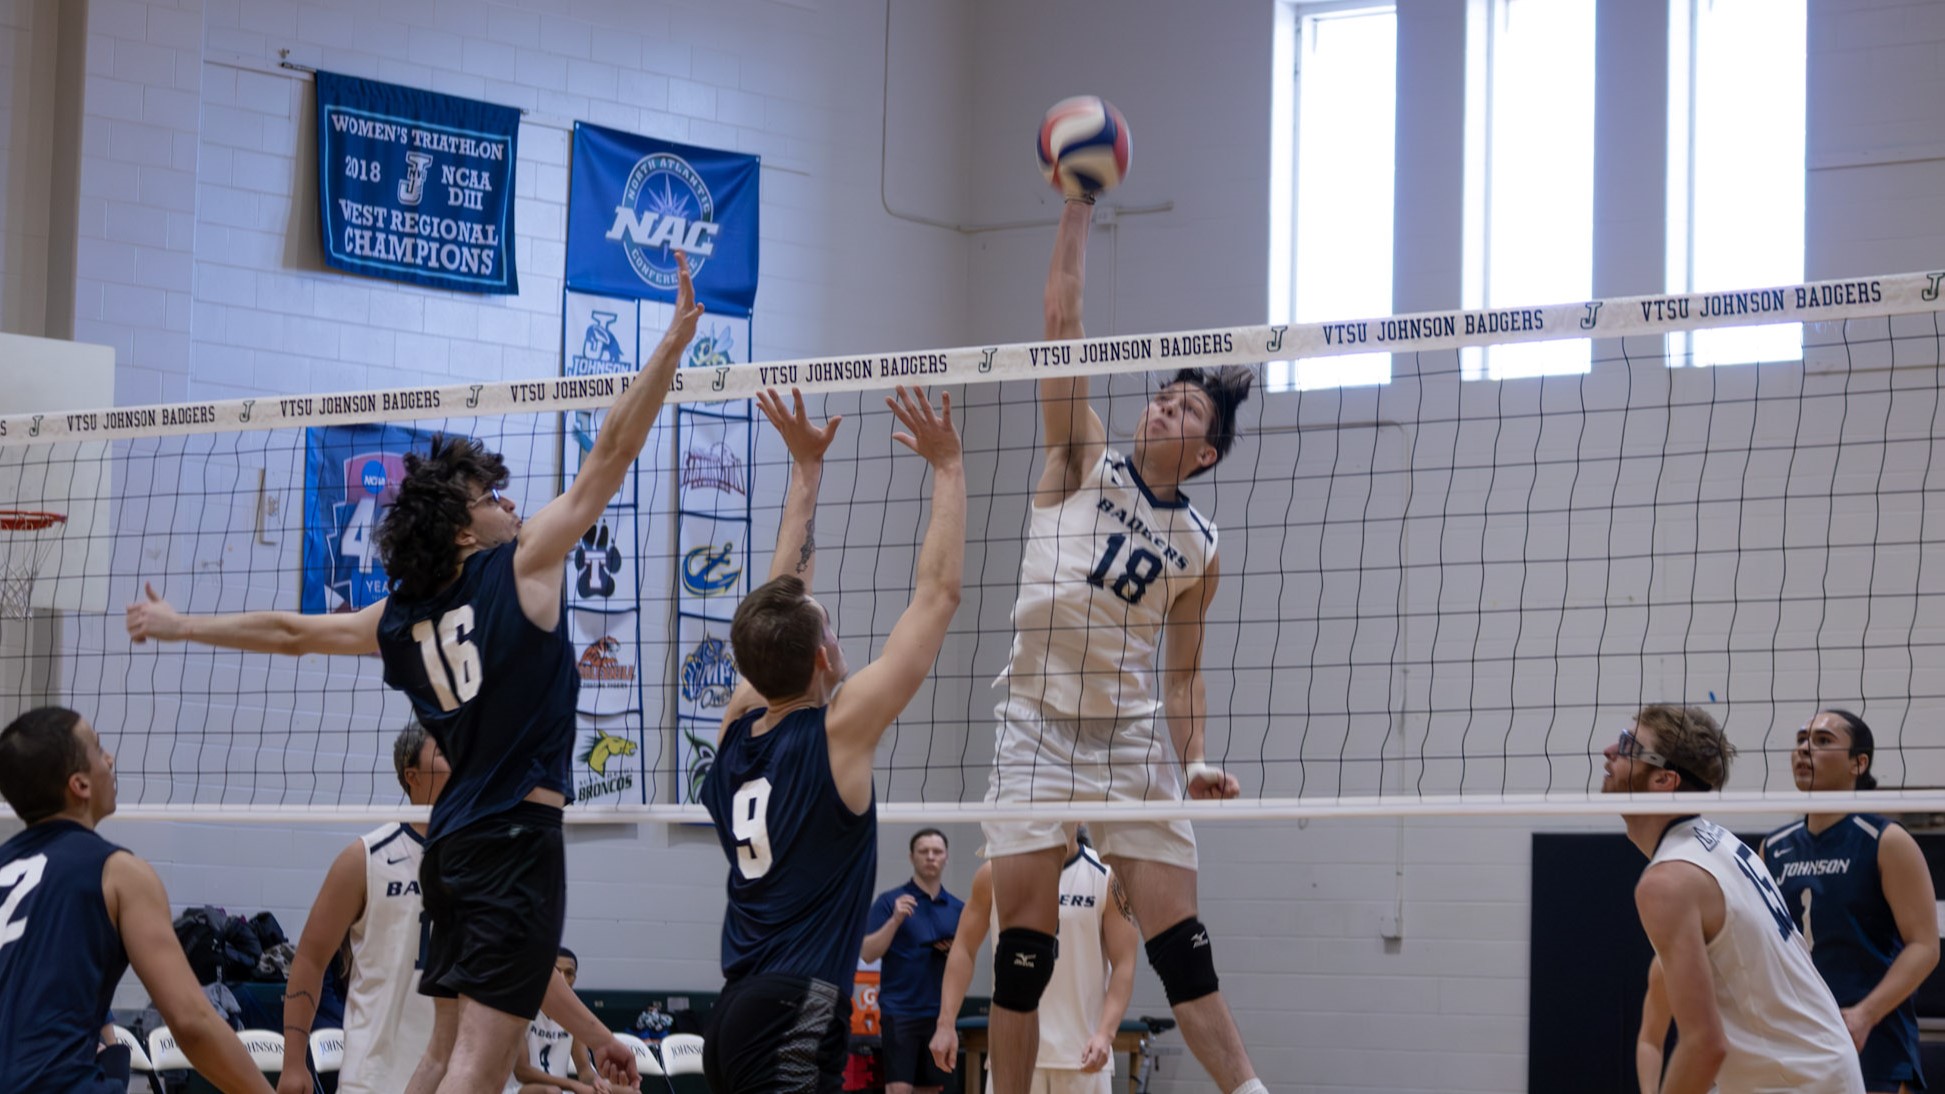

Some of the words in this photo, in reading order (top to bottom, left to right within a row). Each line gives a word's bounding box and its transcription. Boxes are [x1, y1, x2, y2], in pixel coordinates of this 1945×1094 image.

[332, 114, 408, 145] WOMEN'S
[411, 129, 504, 160] TRIATHLON
[345, 155, 381, 182] 2018
[441, 165, 492, 191] NCAA
[628, 160, 656, 201] NORTH
[660, 157, 710, 213] ATLANTIC
[448, 187, 484, 211] DIII
[338, 198, 387, 228] WEST
[390, 210, 498, 246] REGIONAL
[605, 206, 719, 256] NAC
[344, 227, 494, 275] CHAMPIONS
[631, 248, 698, 284] CONFEREE
[1641, 299, 1689, 322] VTSU
[1700, 289, 1785, 317] JOHNSON
[1795, 281, 1881, 309] BADGERS
[1323, 322, 1367, 345] VTSU
[1377, 316, 1455, 342] JOHNSON
[1465, 310, 1543, 336] BADGERS
[567, 355, 632, 377] JOHNSON
[1029, 346, 1071, 367] VTSU
[1079, 339, 1152, 364] JOHNSON
[1160, 333, 1233, 358] BADGERS
[760, 365, 797, 385] VTSU
[806, 359, 872, 382] JOHNSON
[880, 354, 947, 377] BADGERS
[280, 399, 312, 417] VTSU
[319, 394, 376, 415] JOHNSON
[383, 390, 440, 410] BADGERS
[511, 383, 545, 402] VTSU
[552, 377, 614, 400] JOHNSON
[67, 413, 97, 432] VTSU
[103, 409, 156, 430] JOHNSON
[162, 405, 215, 426] BADGERS
[1087, 532, 1163, 605] 18
[411, 604, 483, 712] 16
[578, 775, 632, 802] BRONCOS
[732, 776, 773, 880] 9
[1776, 858, 1850, 887] JOHNSON
[0, 852, 48, 948] 2
